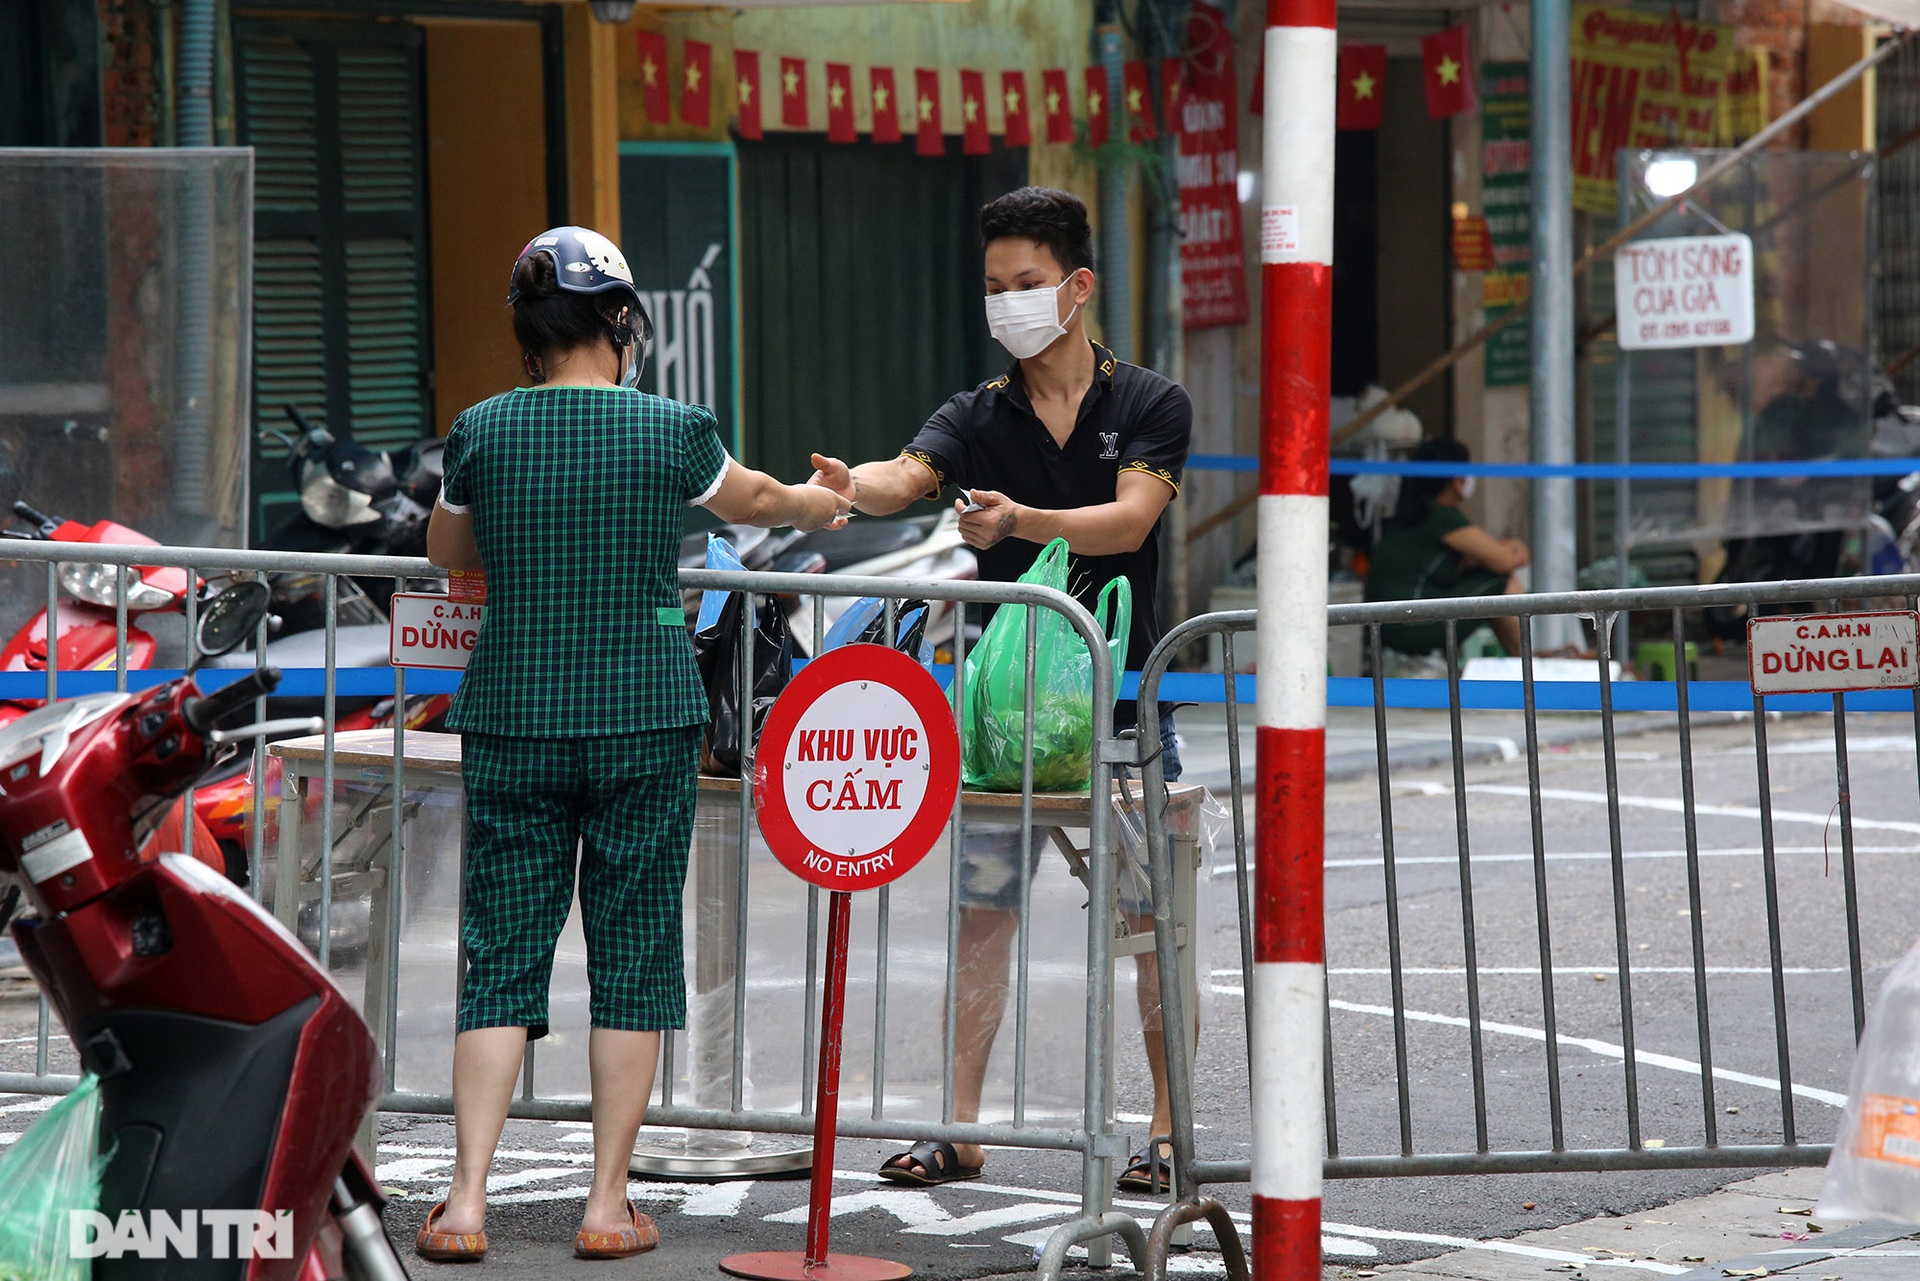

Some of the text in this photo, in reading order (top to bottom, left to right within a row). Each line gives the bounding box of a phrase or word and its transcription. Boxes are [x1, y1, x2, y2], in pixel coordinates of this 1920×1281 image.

[402, 620, 478, 651] DỪNG
[1796, 623, 1871, 639] C.A.H.N
[1762, 644, 1908, 674] DỪNG LẠI
[798, 725, 918, 768] KHU VỰC
[805, 768, 903, 811] CẤM
[802, 848, 895, 877] NO ENTRY
